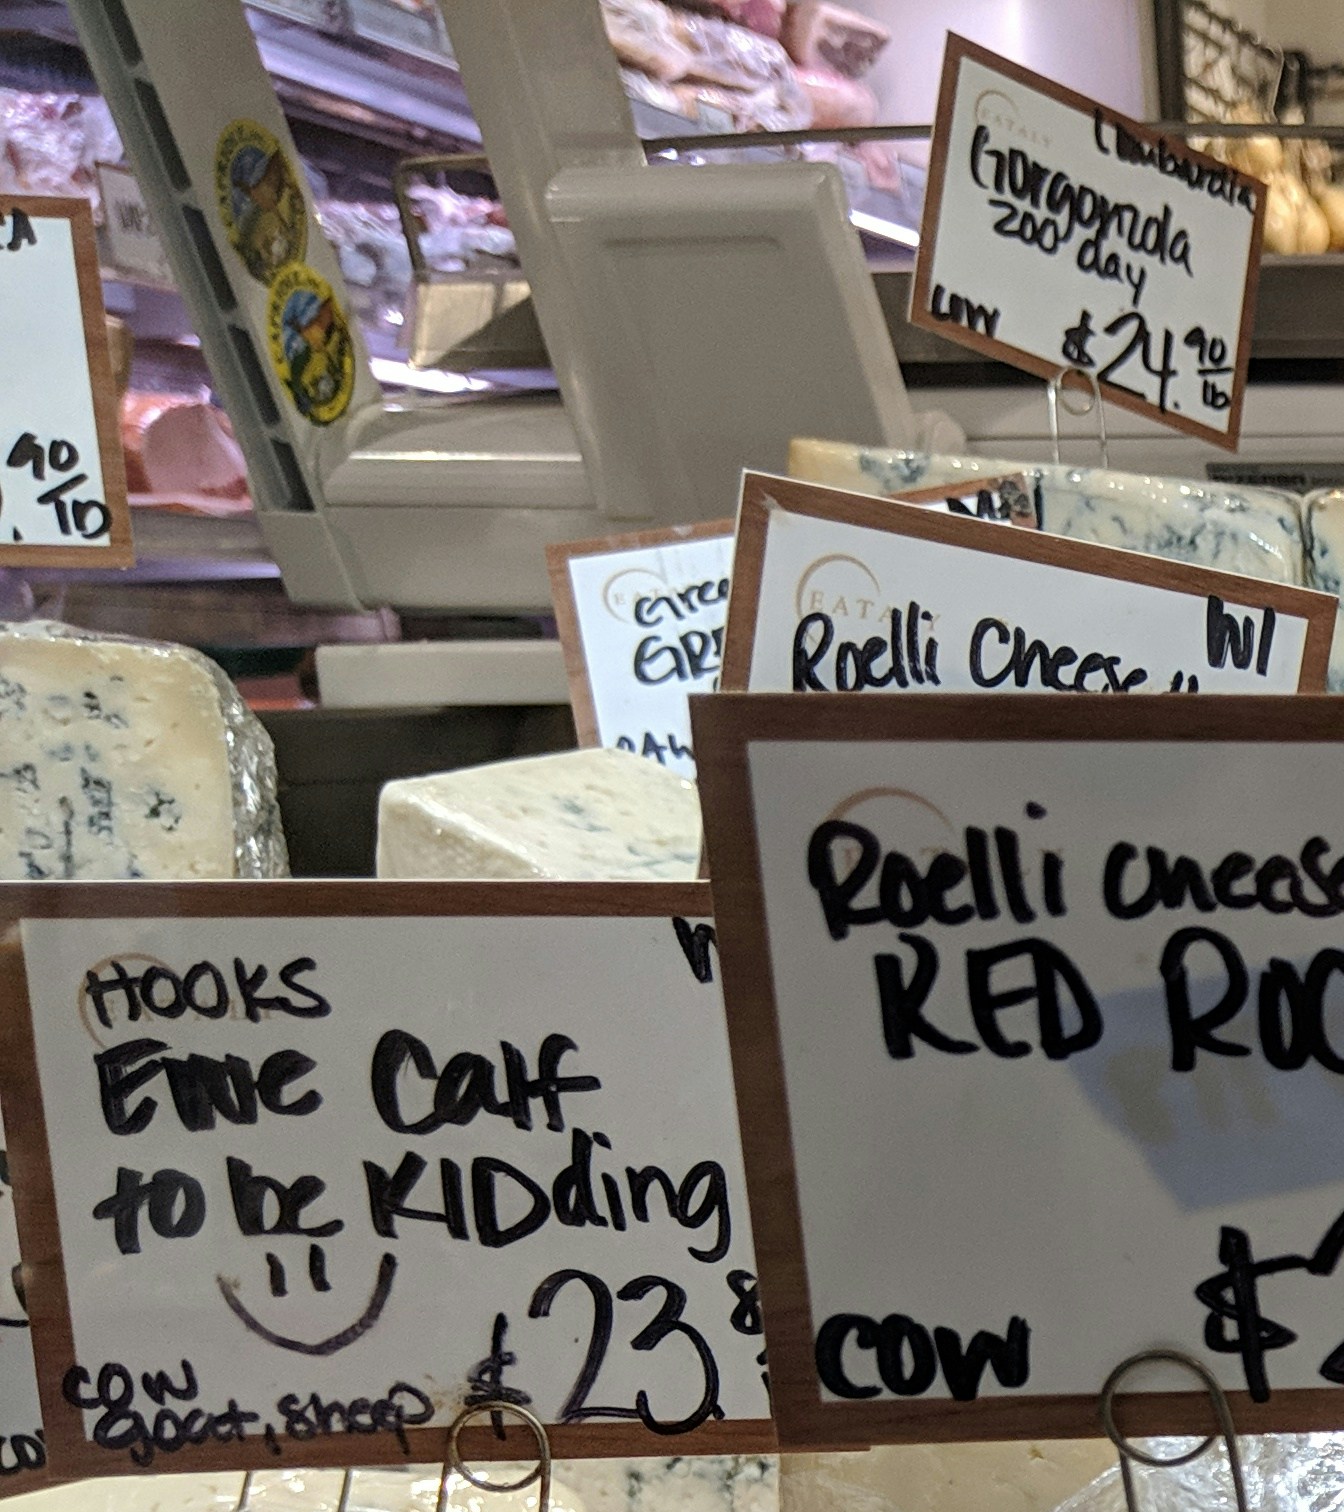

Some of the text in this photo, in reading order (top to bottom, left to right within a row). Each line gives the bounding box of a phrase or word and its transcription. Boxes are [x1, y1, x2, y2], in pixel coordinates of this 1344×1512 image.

[987, 198, 1147, 307] 200 day
[793, 601, 941, 692] Roelli
[807, 802, 1067, 938] Roelli
[874, 931, 1103, 1060] RED
[372, 1029, 601, 1132] Calf
[226, 1156, 345, 1237] be
